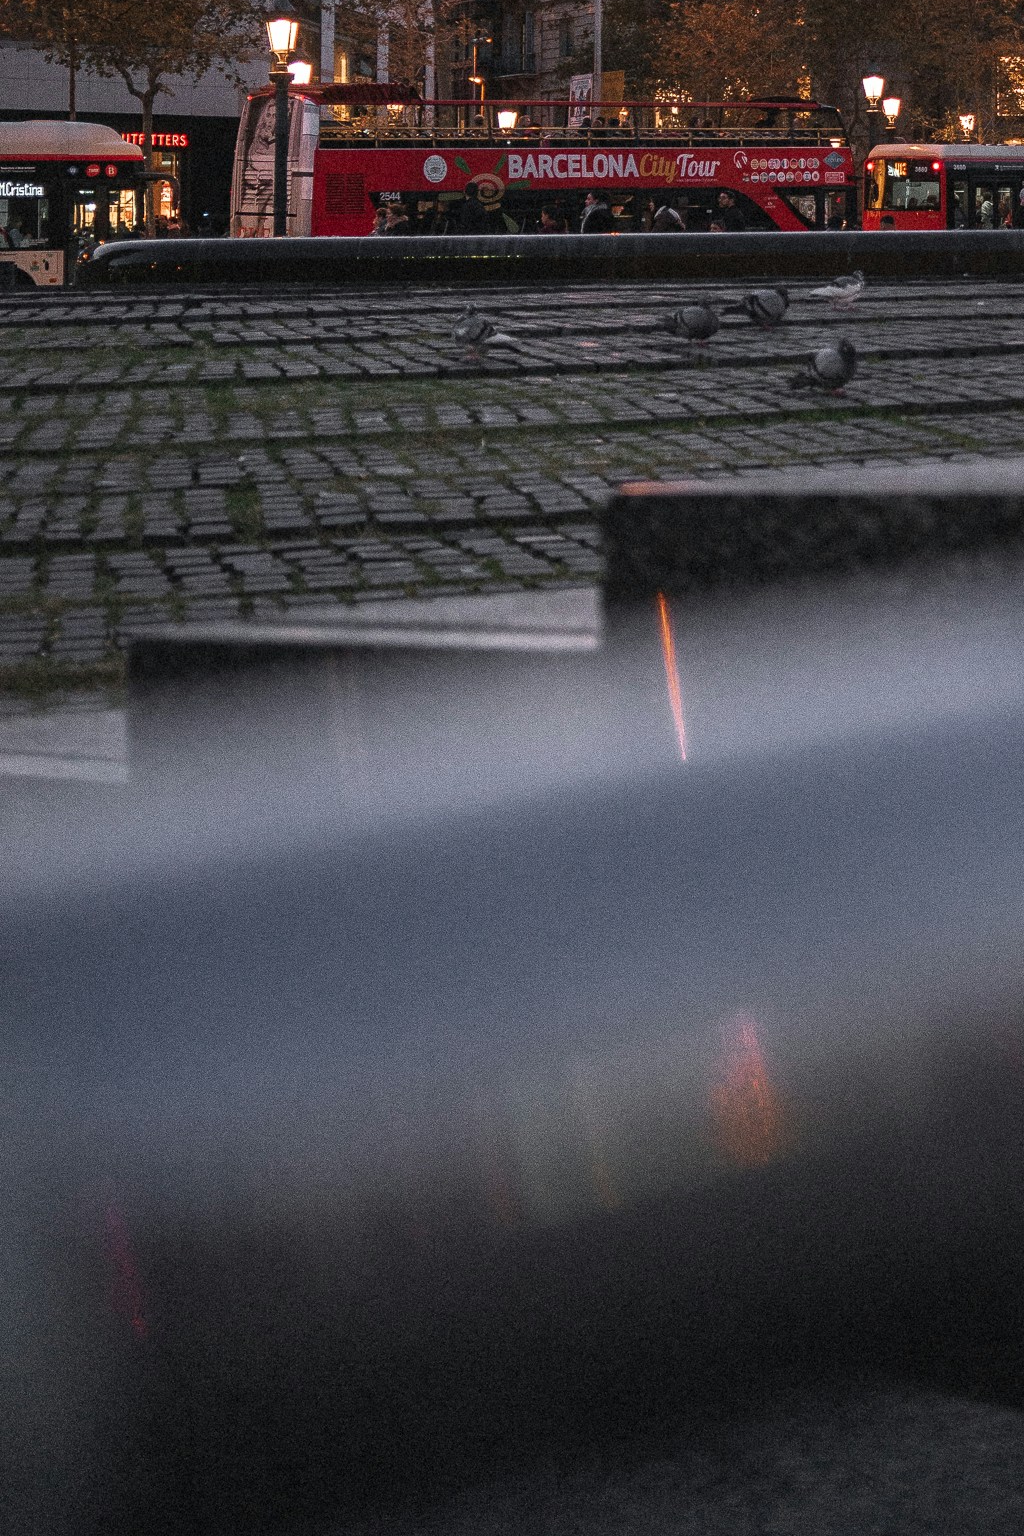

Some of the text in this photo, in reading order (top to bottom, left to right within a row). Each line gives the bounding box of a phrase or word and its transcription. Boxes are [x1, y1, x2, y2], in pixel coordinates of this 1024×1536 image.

[508, 152, 721, 183] BARCELONA City Tour
[379, 192, 401, 200] 2544
